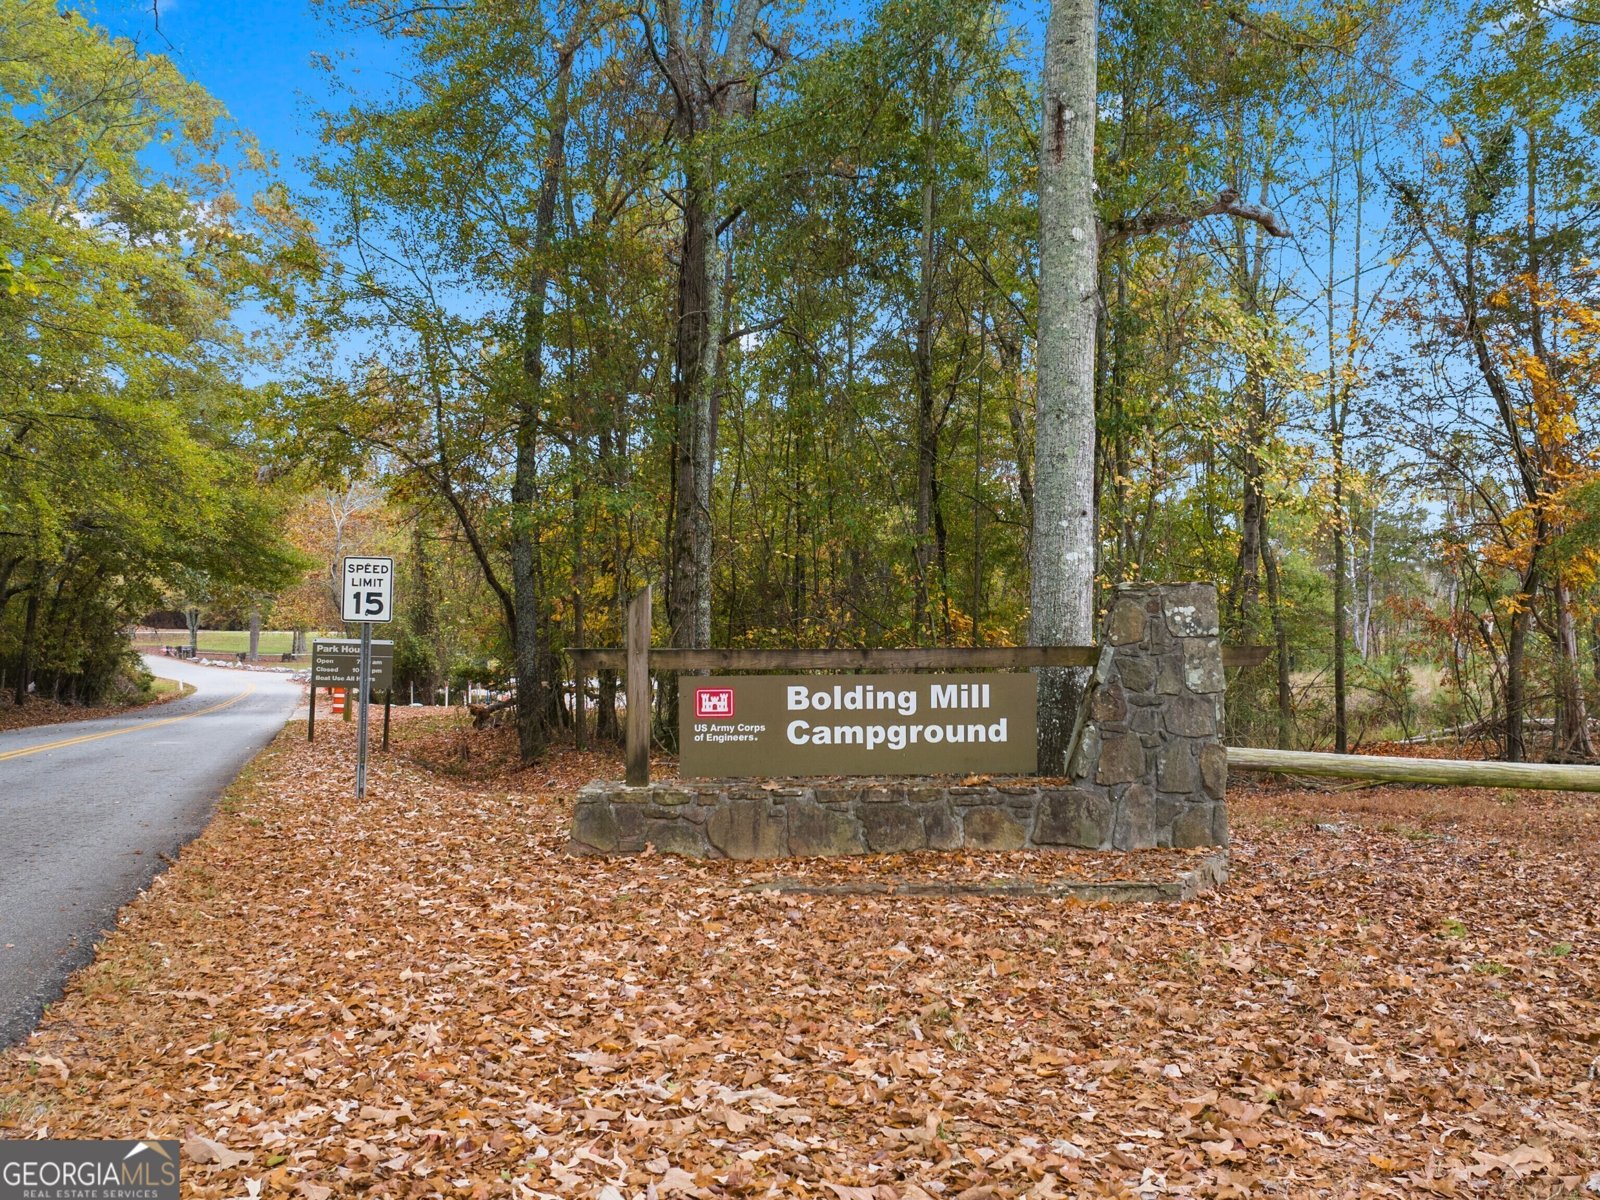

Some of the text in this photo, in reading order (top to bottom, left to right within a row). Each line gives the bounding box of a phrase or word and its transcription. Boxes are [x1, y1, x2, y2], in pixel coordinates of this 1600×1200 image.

[348, 563, 389, 574] SPEED
[351, 577, 384, 587] LIMIT
[353, 591, 384, 615] 15
[316, 644, 361, 653] Park Hou
[787, 684, 990, 716] Bolding Mill
[694, 723, 766, 734] US Army Corps
[786, 718, 1008, 750] Campground
[694, 733, 704, 742] of
